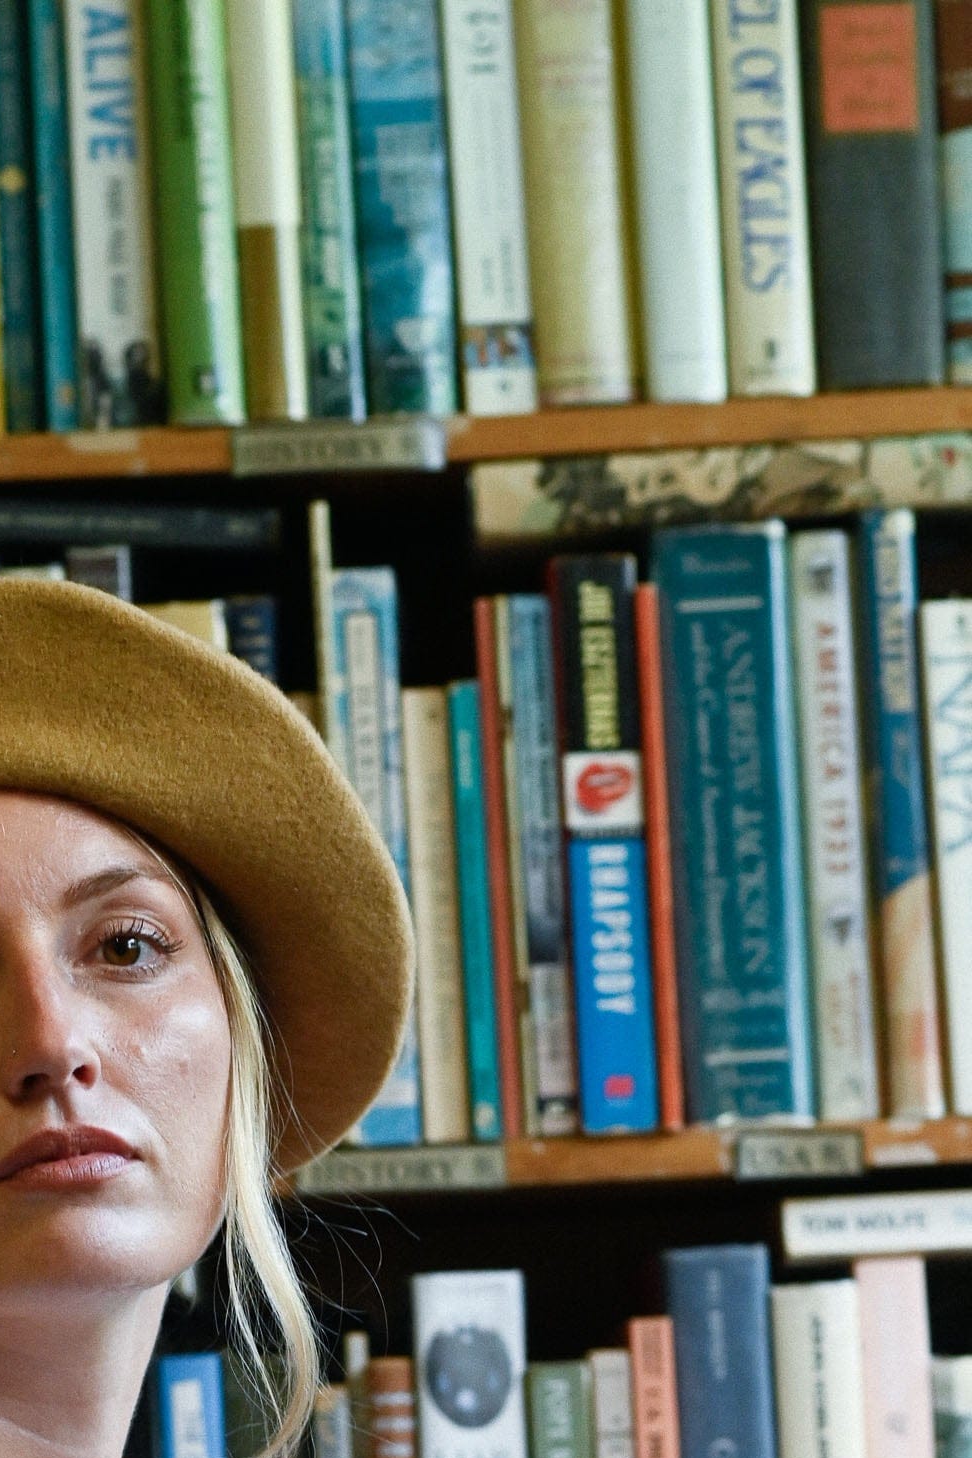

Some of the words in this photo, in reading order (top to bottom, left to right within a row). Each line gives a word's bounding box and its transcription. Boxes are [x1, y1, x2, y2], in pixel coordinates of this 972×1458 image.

[82, 6, 138, 163] ALIVE
[734, 116, 795, 293] EAGLES
[719, 621, 767, 796] ANDREW
[815, 621, 847, 780] AMERICA
[587, 843, 638, 1018] RHAPSODY
[730, 802, 777, 980] JACKSON
[542, 1376, 577, 1440] POPE
